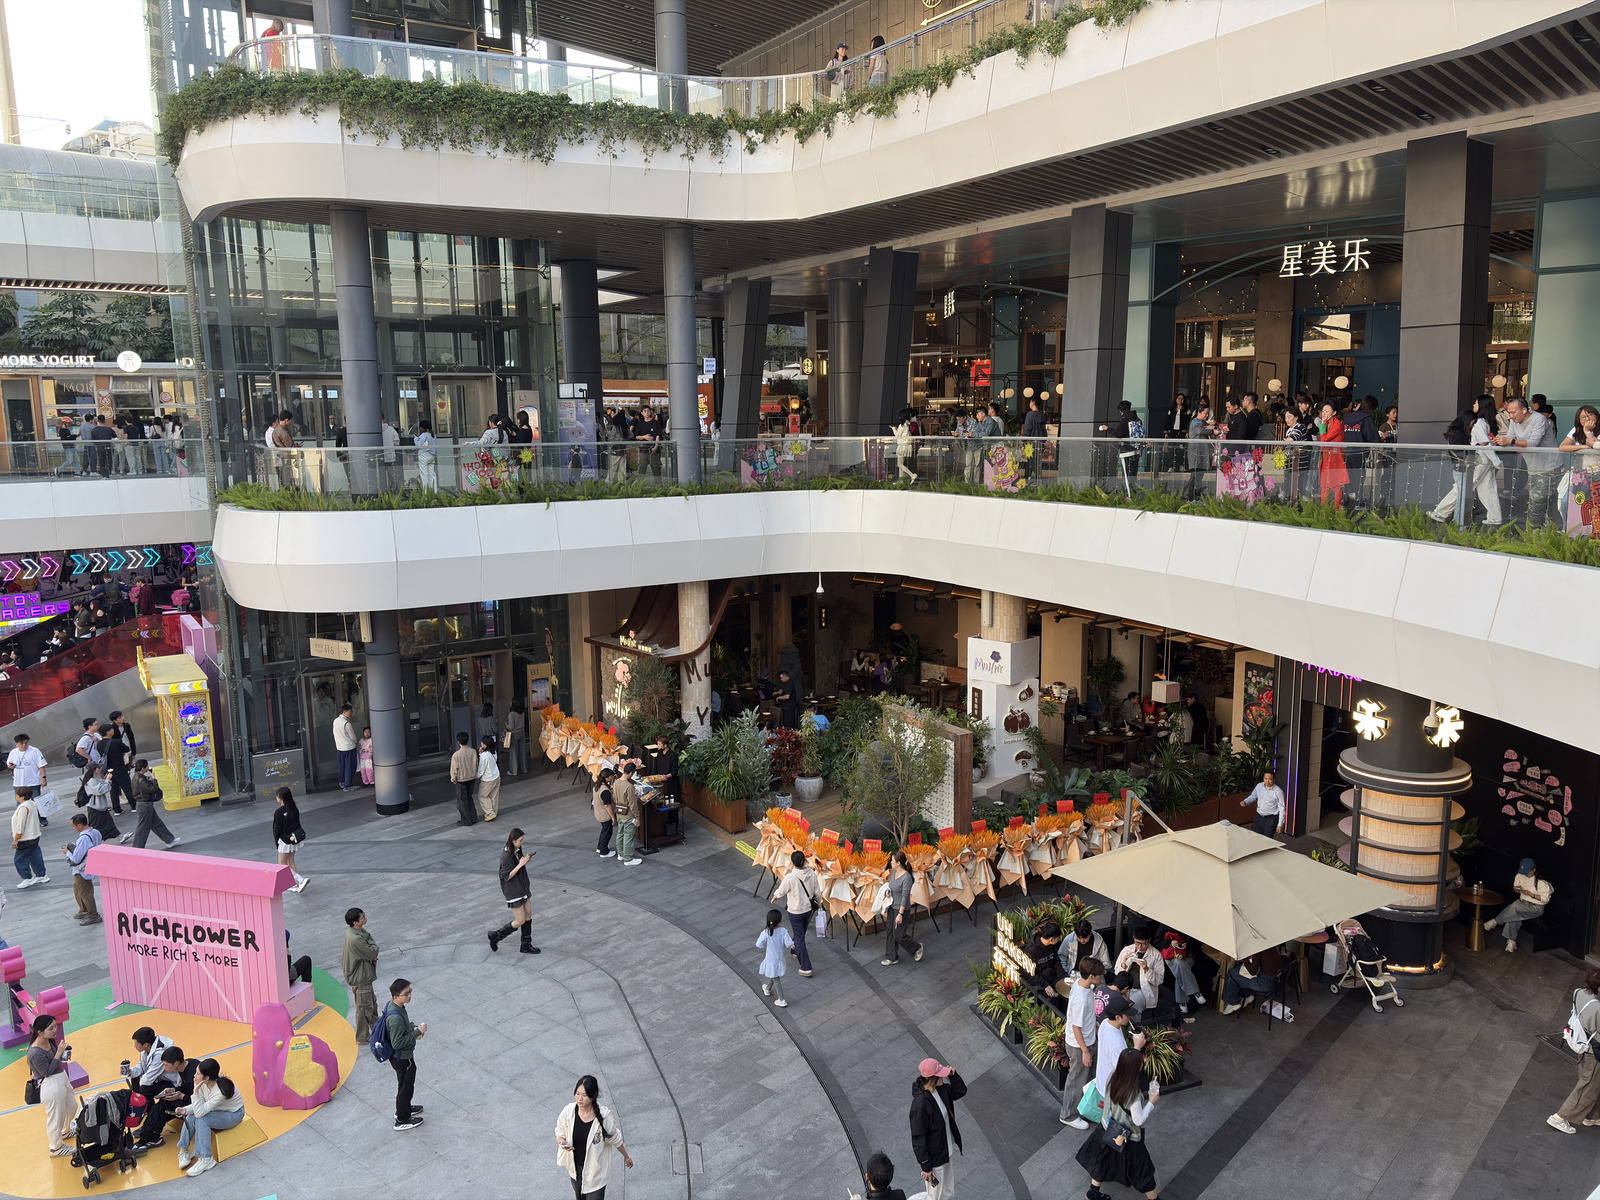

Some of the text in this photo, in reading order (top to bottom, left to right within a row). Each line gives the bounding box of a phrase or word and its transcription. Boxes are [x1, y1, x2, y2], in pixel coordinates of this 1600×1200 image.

[1279, 238, 1371, 277] 星美乐
[0, 355, 96, 367] MORE YOGURT
[0, 592, 39, 608] TOY
[117, 912, 260, 952] RICHFLOWER
[997, 911, 1014, 940] UH
[127, 942, 239, 967] MORE RICH & MORE
[997, 930, 1037, 977] BAKERY
